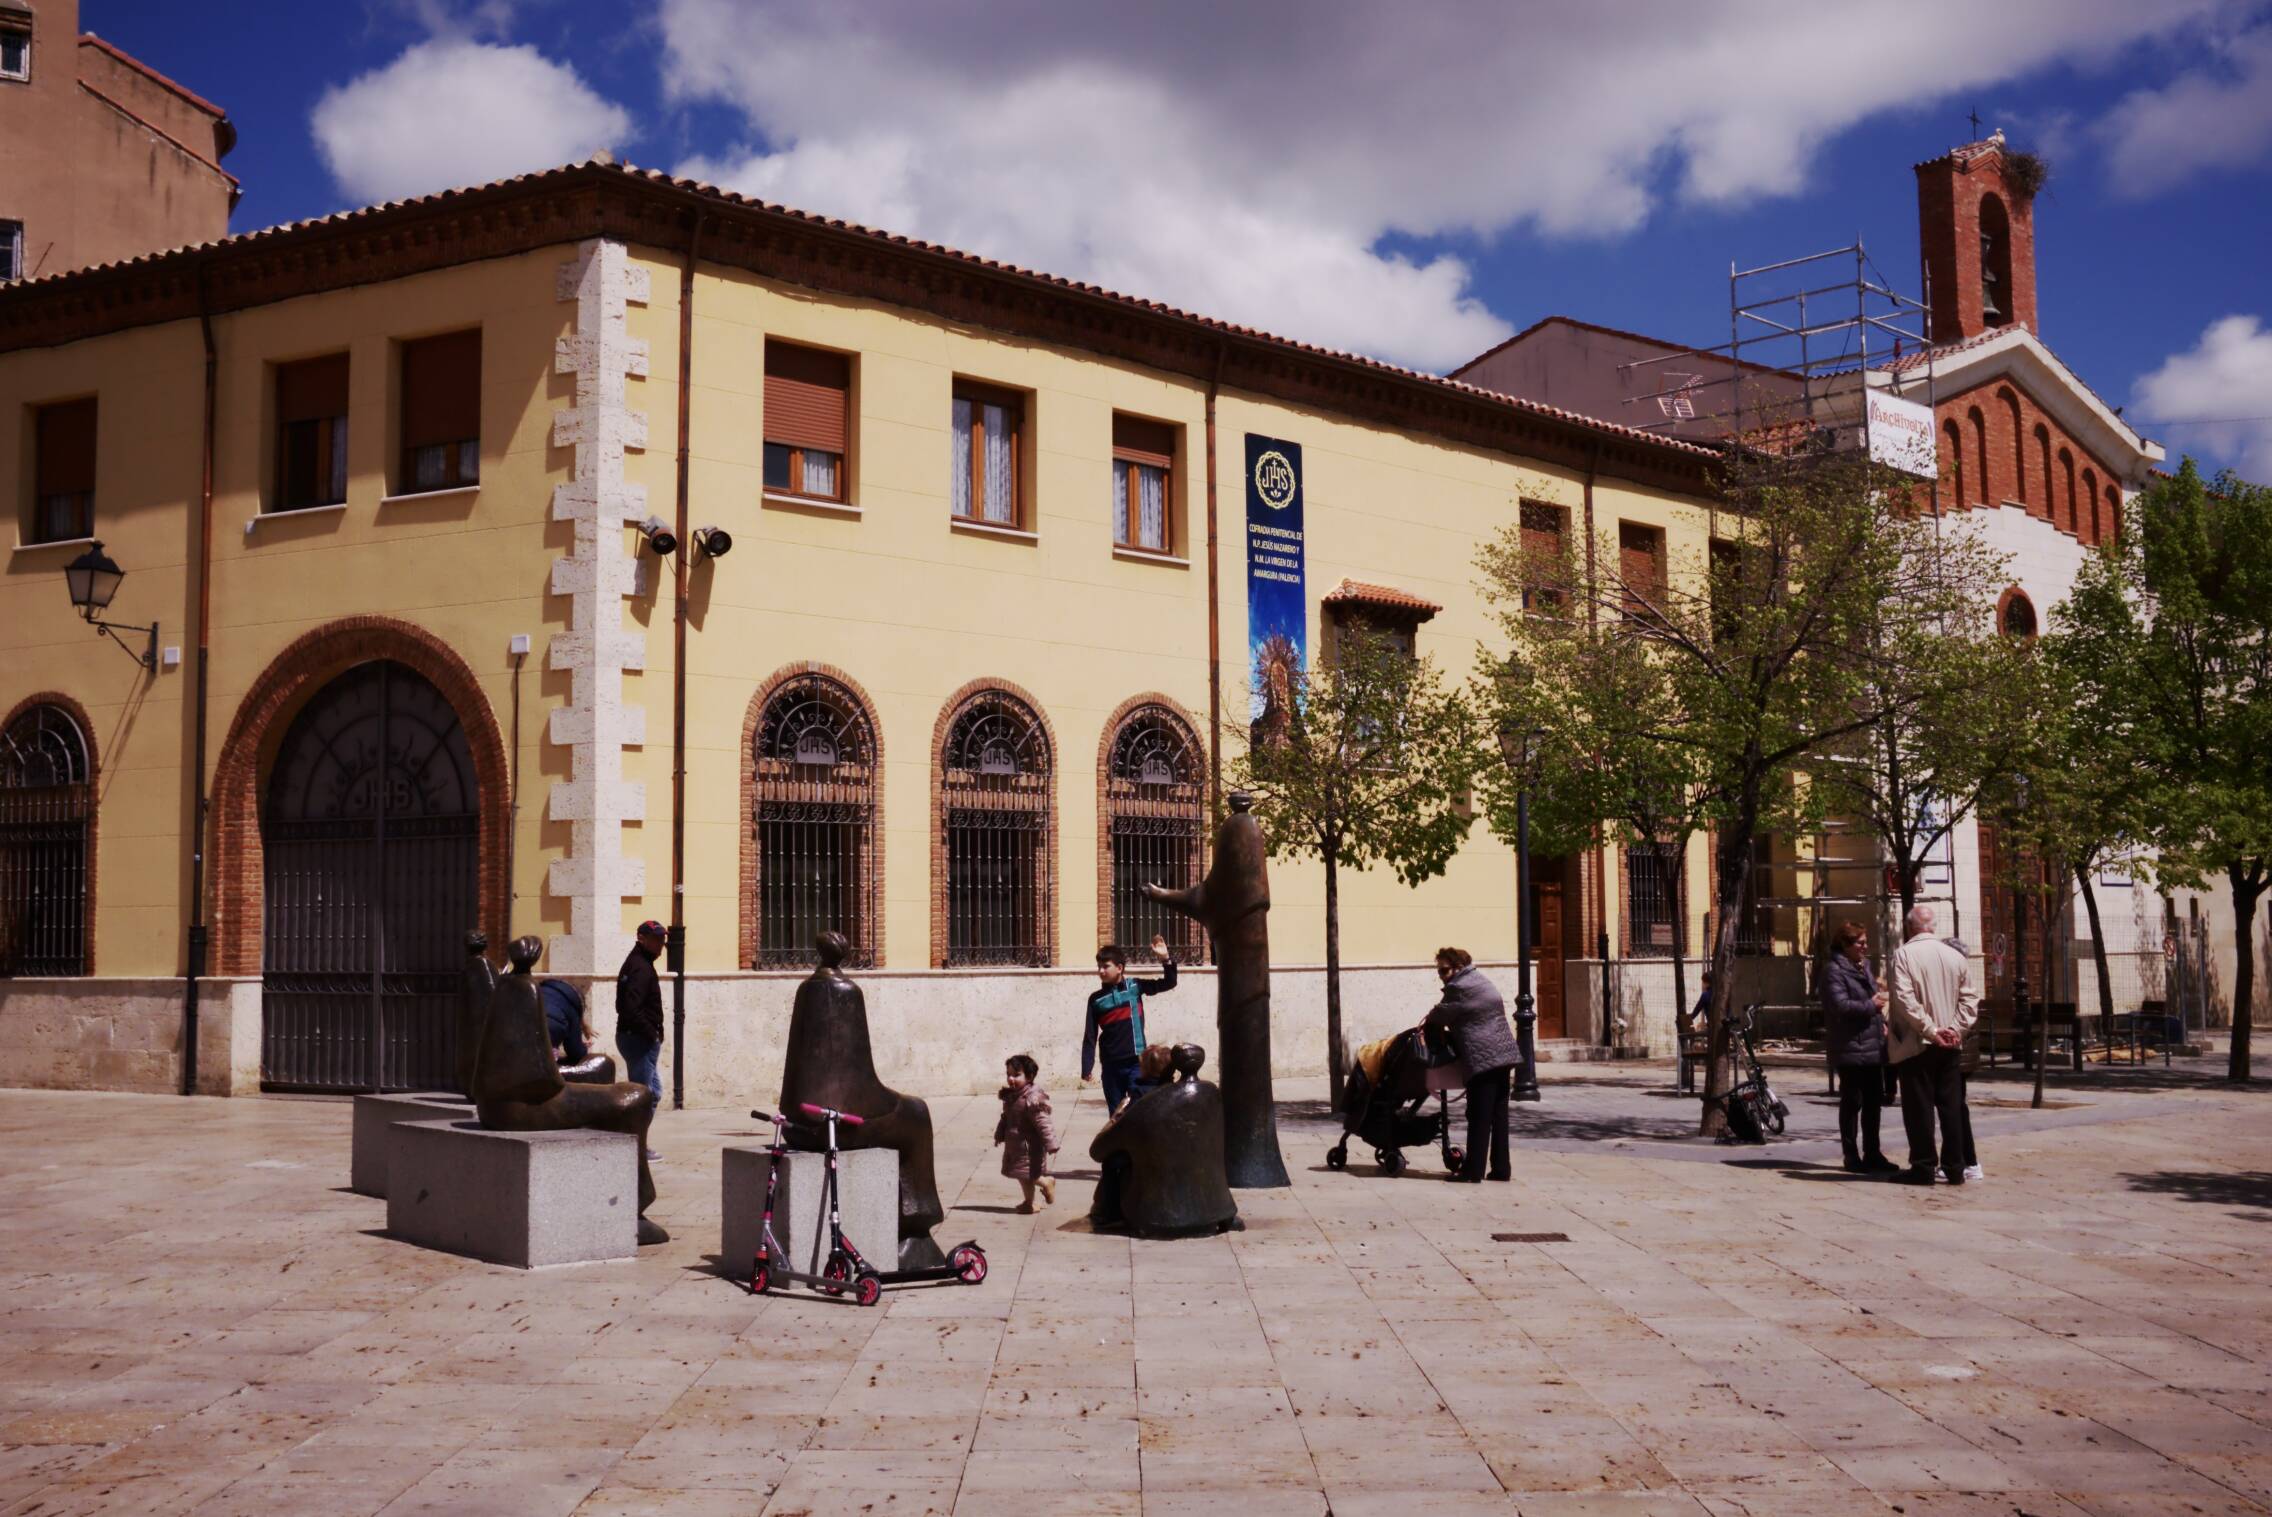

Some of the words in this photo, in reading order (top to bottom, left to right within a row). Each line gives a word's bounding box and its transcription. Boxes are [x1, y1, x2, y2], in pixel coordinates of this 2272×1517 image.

[1262, 464, 1288, 491] JHS
[1296, 531, 1302, 541] DE
[1264, 556, 1270, 565] LA
[1286, 559, 1292, 568] DE
[1292, 560, 1298, 569] LA
[800, 736, 830, 754] JHS
[984, 749, 1010, 766] JHS
[1144, 759, 1169, 776] JHS
